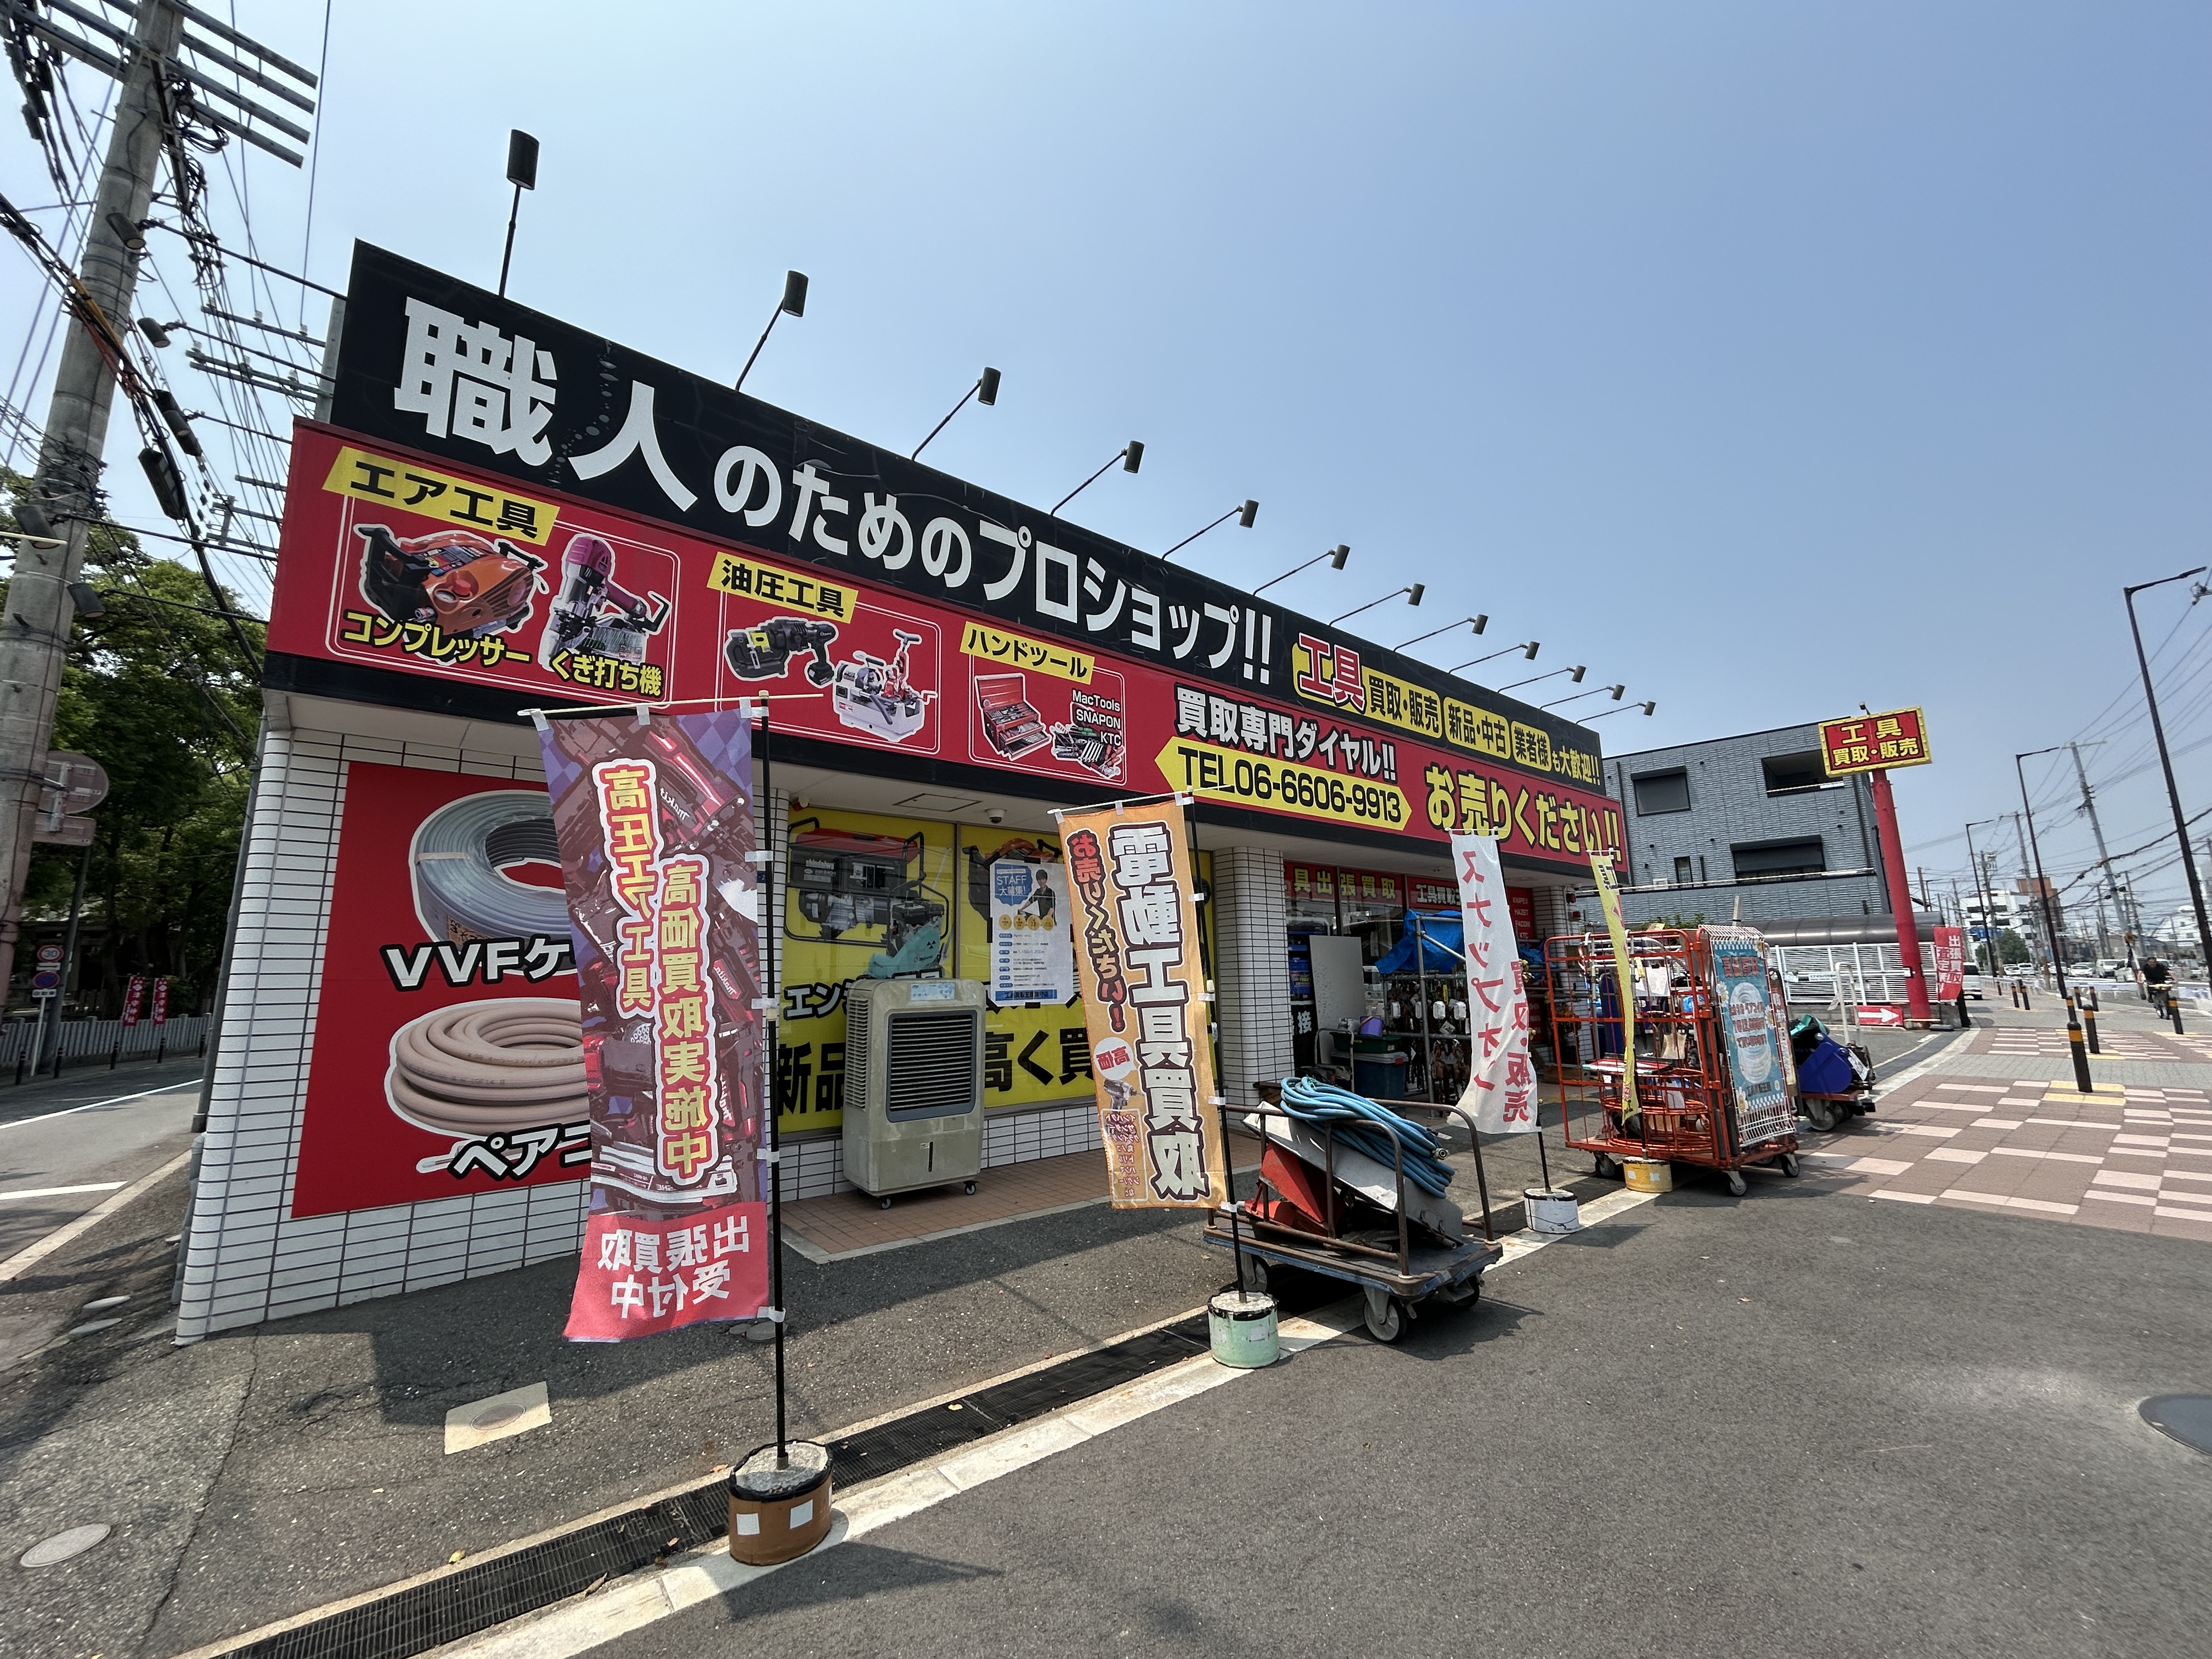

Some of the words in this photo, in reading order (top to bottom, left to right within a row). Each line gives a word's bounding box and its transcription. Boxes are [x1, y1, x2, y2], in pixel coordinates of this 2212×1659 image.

[351, 460, 538, 540] エア工具
[394, 297, 1272, 685] 職人のためのプロショップ!!
[721, 559, 845, 619] 油圧工具
[342, 610, 533, 667] コンプレッサー
[968, 629, 1087, 678] ハンドツール
[550, 649, 663, 697] くぎ打ち機
[1072, 689, 1121, 712] MacTools
[1076, 709, 1121, 729] SNAPON
[1100, 732, 1121, 747] KTC
[1177, 687, 1397, 781] 買取専門ダイヤル!!
[1448, 703, 1506, 756] 新品・中古
[1832, 737, 1919, 766] 買取・販売
[1841, 718, 1902, 744] 工具
[1177, 746, 1402, 823] TEL06-6606-9913
[1425, 766, 1622, 862] お売りください!!
[996, 875, 1027, 885] STAFF
[1284, 868, 1396, 900] 具出張買取
[787, 981, 853, 1017] エン
